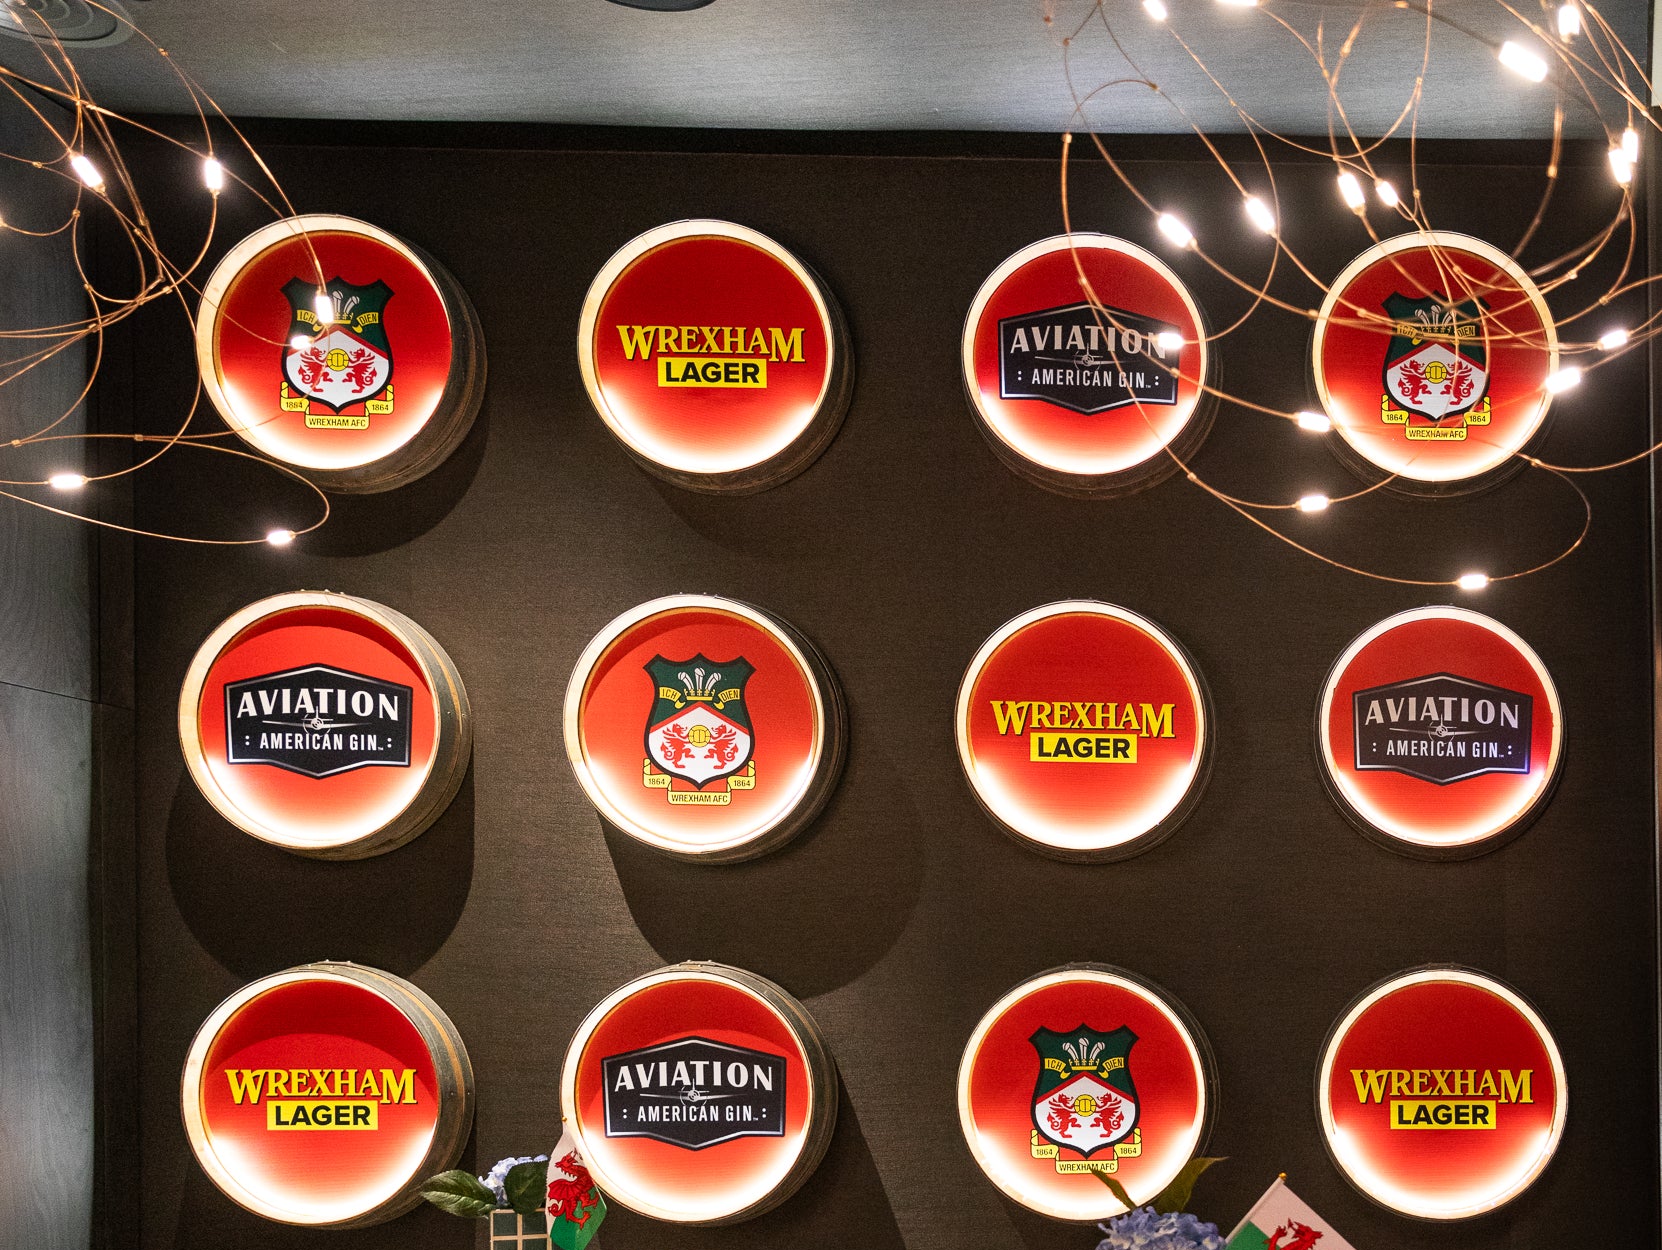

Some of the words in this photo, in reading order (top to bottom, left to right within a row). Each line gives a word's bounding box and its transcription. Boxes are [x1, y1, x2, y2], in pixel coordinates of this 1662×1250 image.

[300, 311, 315, 323] ICH
[359, 313, 378, 325] DIEN
[615, 325, 807, 363] WREXHAM
[1010, 324, 1168, 360] AVIATION
[665, 361, 760, 384] LAGER
[1031, 368, 1112, 388] AMERICAN
[371, 403, 389, 412] 1864
[309, 417, 350, 427] WREXHAM
[350, 419, 367, 427] AFC
[1386, 413, 1404, 421] 1864
[1469, 414, 1487, 423] 1864
[1449, 430, 1465, 439] AFC
[662, 688, 678, 700] ICH
[720, 689, 740, 701] DIEN
[236, 687, 399, 722] AVIATION
[1364, 696, 1520, 729] AVIATION
[989, 700, 1177, 739] WREXHAM
[259, 732, 343, 751] AMERICAN
[1037, 736, 1131, 759] LAGER
[1386, 739, 1467, 758] AMERICAN
[648, 777, 666, 785] 1864
[733, 779, 751, 787] 1864
[671, 793, 712, 803] WREXHAM
[712, 794, 729, 803] AFC
[1047, 1059, 1063, 1071] ICH
[1105, 1058, 1125, 1071] DIEN
[614, 1060, 774, 1092] AVIATION
[224, 1068, 418, 1105] WREXHAM
[1349, 1069, 1535, 1105] WREXHAM
[275, 1105, 371, 1127] LAGER
[637, 1105, 720, 1122] AMERICAN
[1397, 1104, 1491, 1126] LAGER
[1036, 1148, 1053, 1156] 1864
[1119, 1146, 1138, 1155] 1864
[1059, 1162, 1099, 1172] WREXHAM
[1099, 1162, 1116, 1171] AFC
